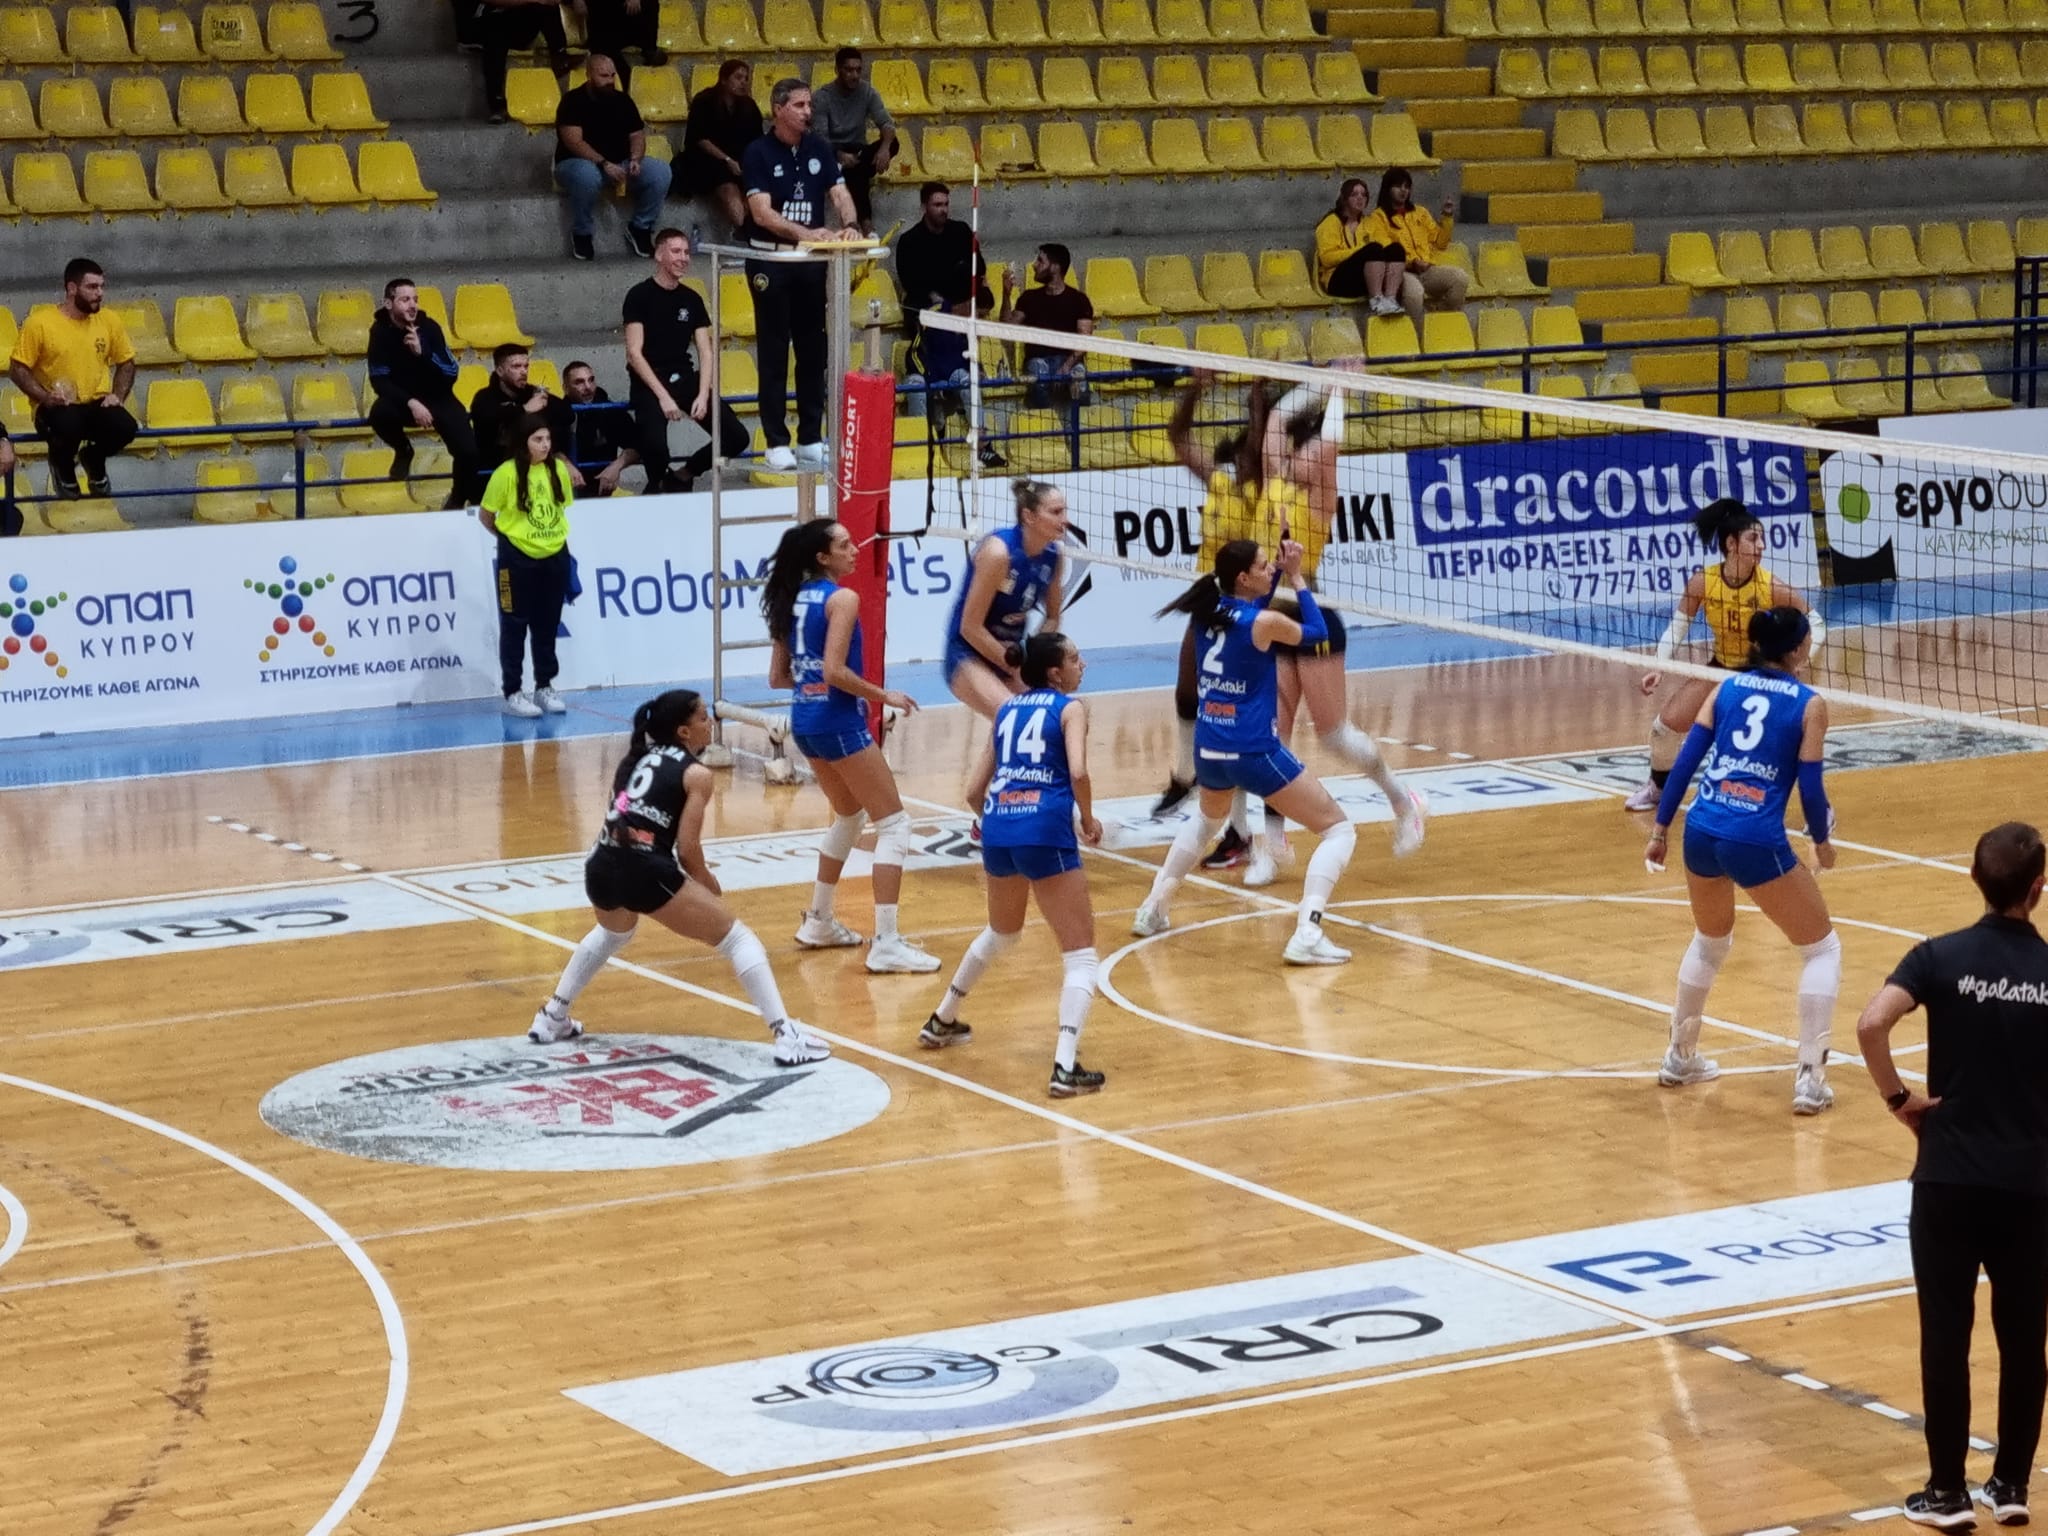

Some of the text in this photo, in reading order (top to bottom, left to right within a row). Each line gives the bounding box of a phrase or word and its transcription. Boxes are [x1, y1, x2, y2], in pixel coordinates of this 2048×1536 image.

[334, 1, 379, 43] 3
[843, 395, 857, 502] VIVISPORT
[1421, 436, 1797, 533] dracoudis
[1428, 538, 1614, 579] ΠΕΡΙΦΡΑΞΕΙΣ
[80, 631, 194, 658] ΚΥΠΡΟΥ
[347, 612, 456, 638] ΚΥΠΡΟΥ
[259, 655, 463, 683] ΣΤΗΡΙΖΟΥΜΕ ΚΑΘΕ ΑΓΩΝΑ
[1202, 626, 1226, 675] 2
[0, 676, 200, 704] ΤΗΡΙΖΟΥΜΕ ΚΑΘΕ ΑΓΩΝΑ
[1733, 674, 1799, 698] VERONIKA
[997, 707, 1046, 764] 14
[1732, 694, 1770, 751] 3
[626, 753, 662, 799] 6
[120, 910, 349, 943] CRI
[1142, 1310, 1443, 1373] CRI
[752, 1345, 1061, 1404] GROUP
